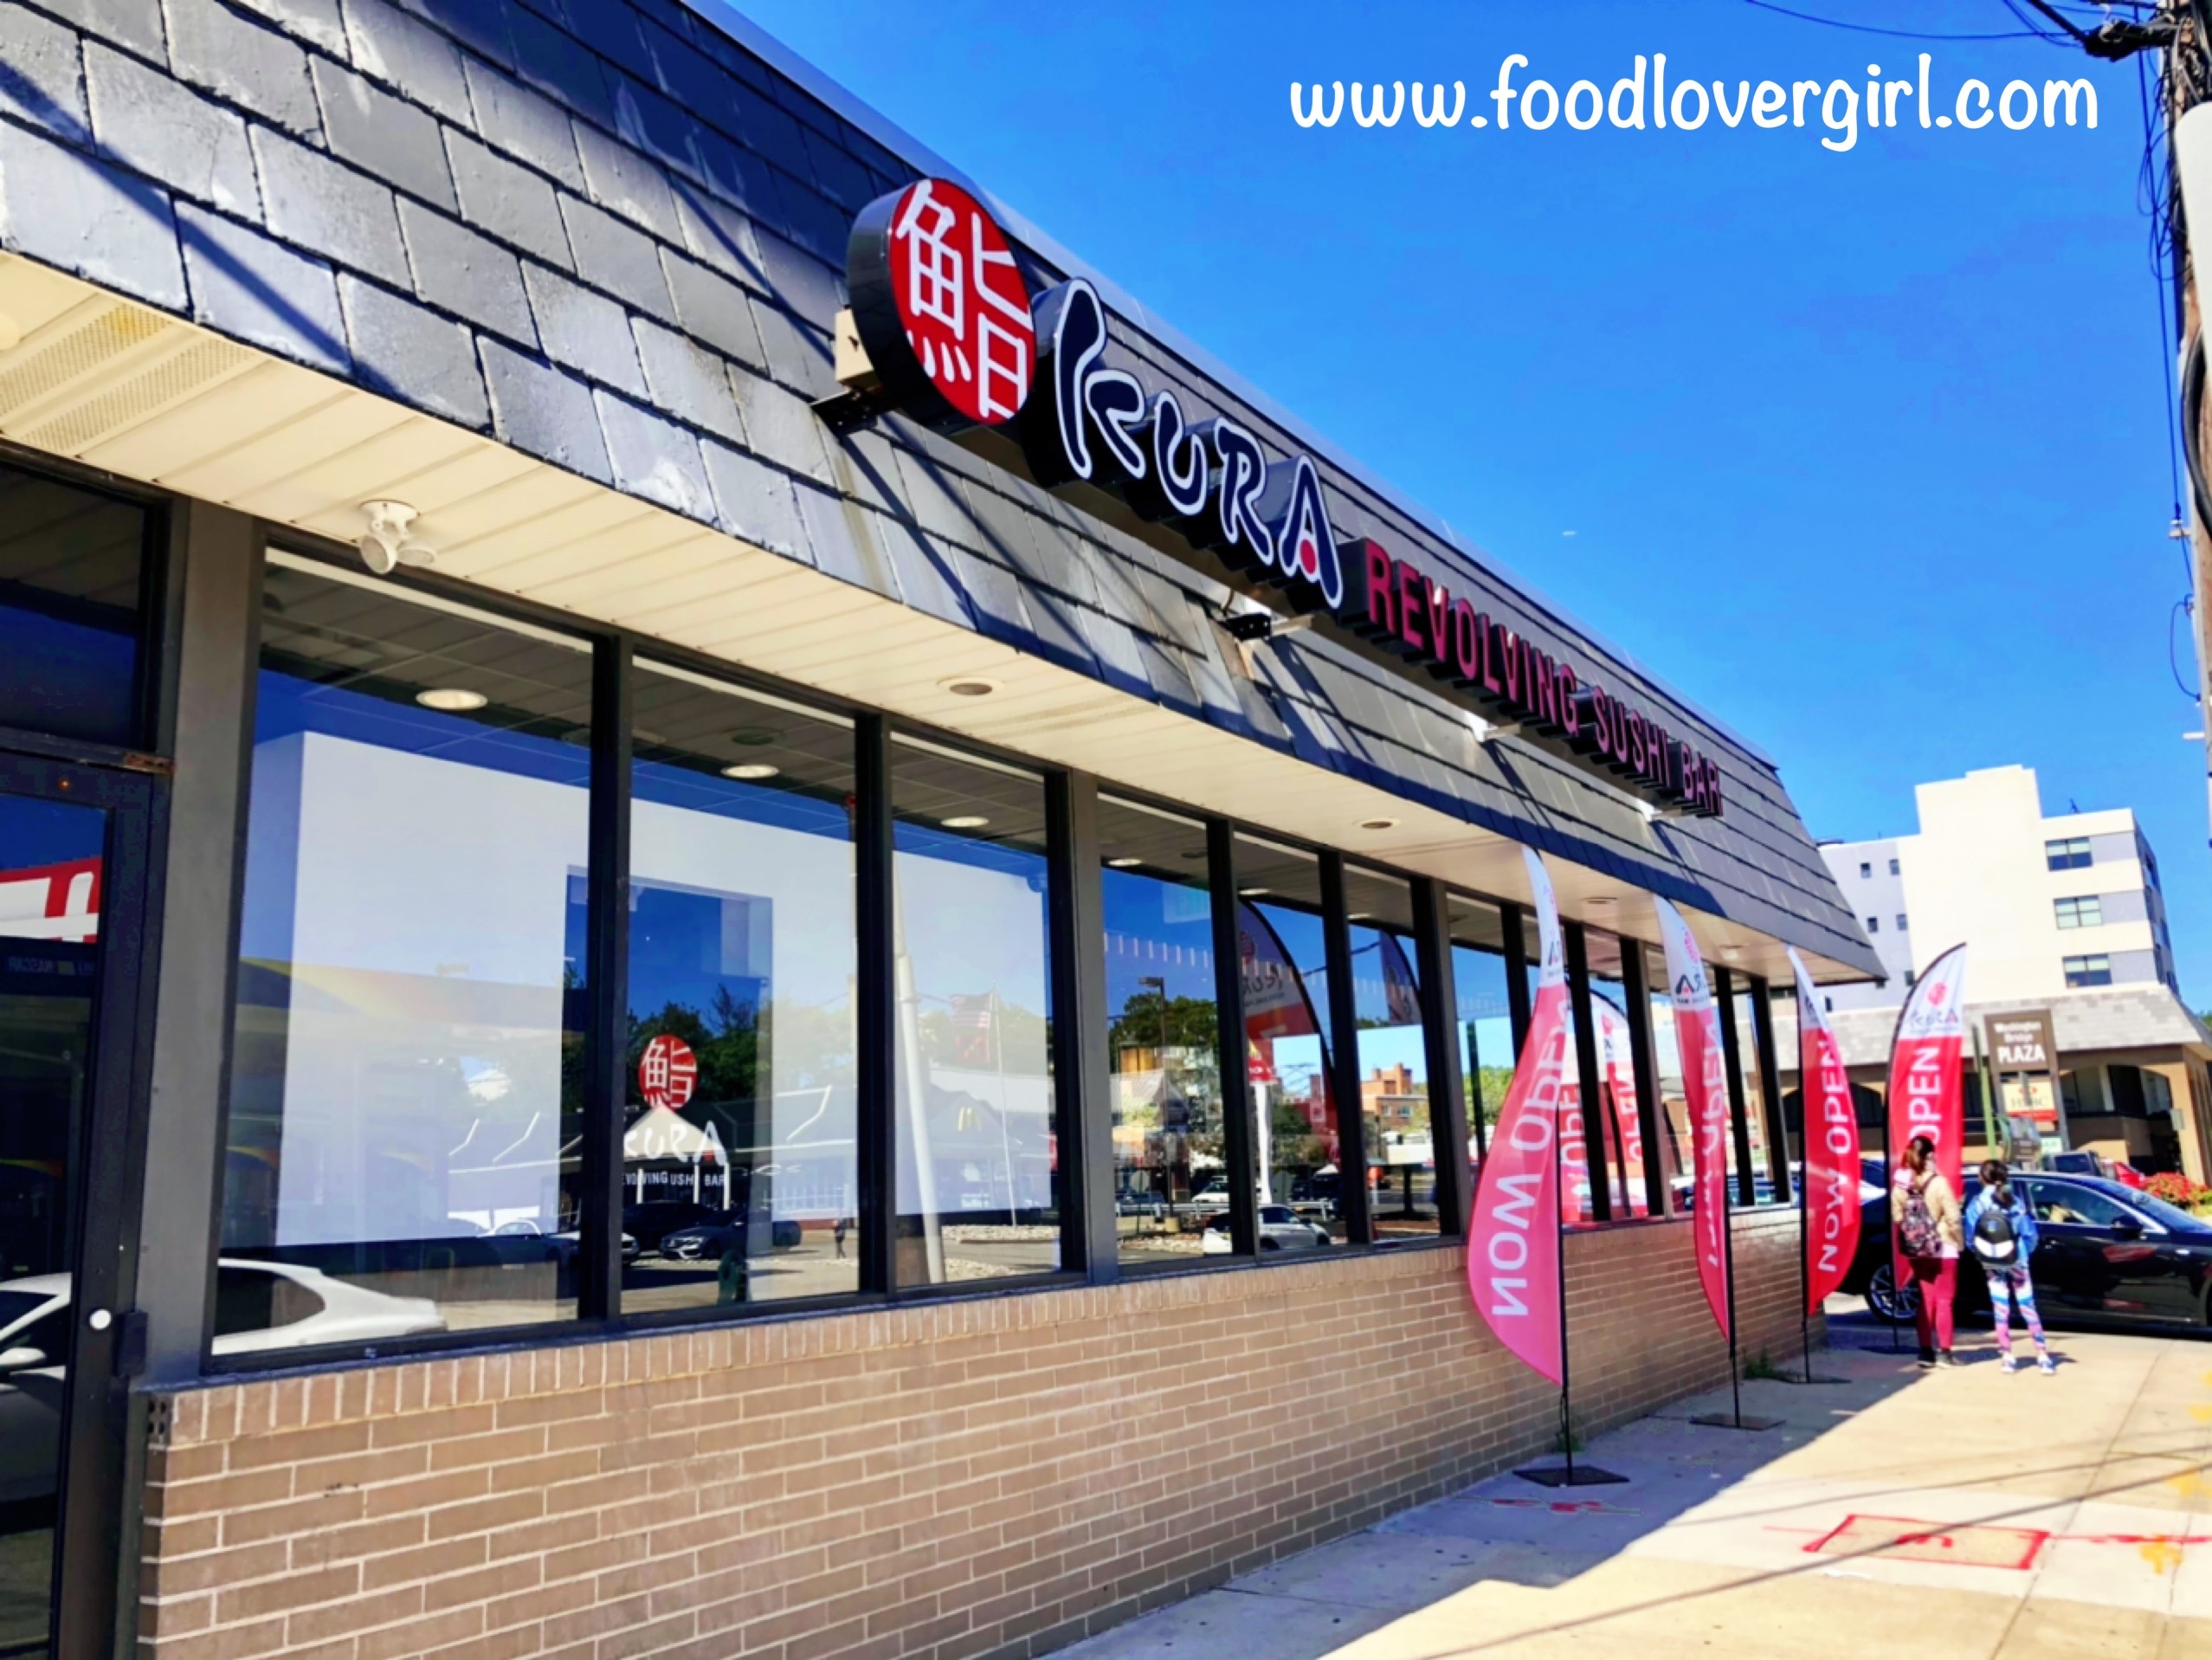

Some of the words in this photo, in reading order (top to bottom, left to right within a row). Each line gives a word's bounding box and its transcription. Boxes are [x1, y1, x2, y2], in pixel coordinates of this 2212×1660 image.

[895, 179, 1033, 420] 鮨
[1054, 277, 1343, 608] KURA
[1365, 538, 1579, 736] REVOLVING
[1592, 687, 1671, 785] SUSHI
[1680, 742, 1724, 817] BAR
[1817, 1040, 1852, 1155] OPEN
[1997, 1044, 2046, 1063] PLAZA
[1817, 1168, 1849, 1272] NOW
